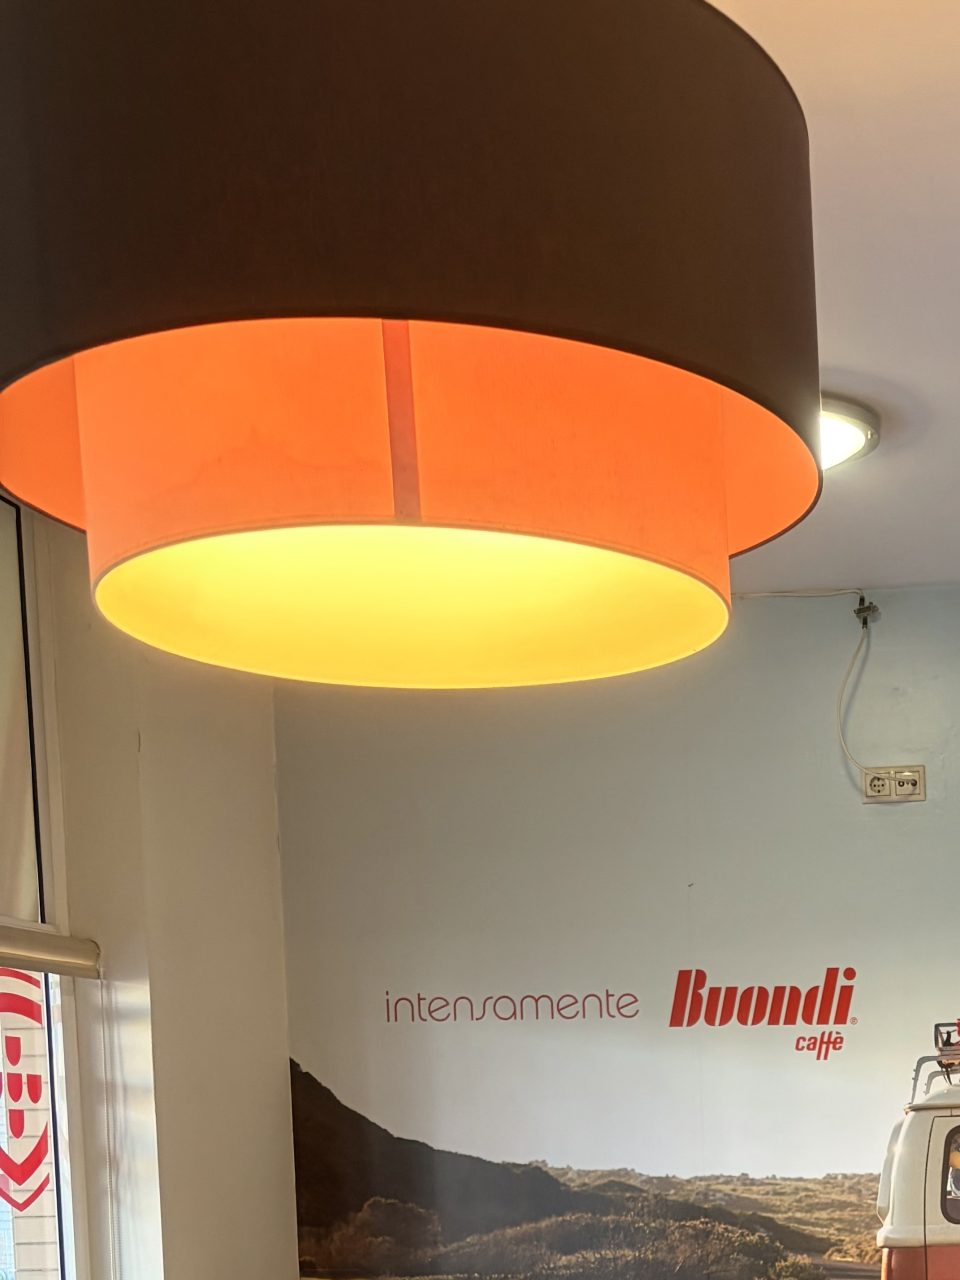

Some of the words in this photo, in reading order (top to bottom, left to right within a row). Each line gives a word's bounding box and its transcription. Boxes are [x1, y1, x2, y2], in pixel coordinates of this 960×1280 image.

[385, 989, 640, 1023] intensamente
[668, 966, 857, 1028] Buondi
[795, 1030, 844, 1061] caffè
